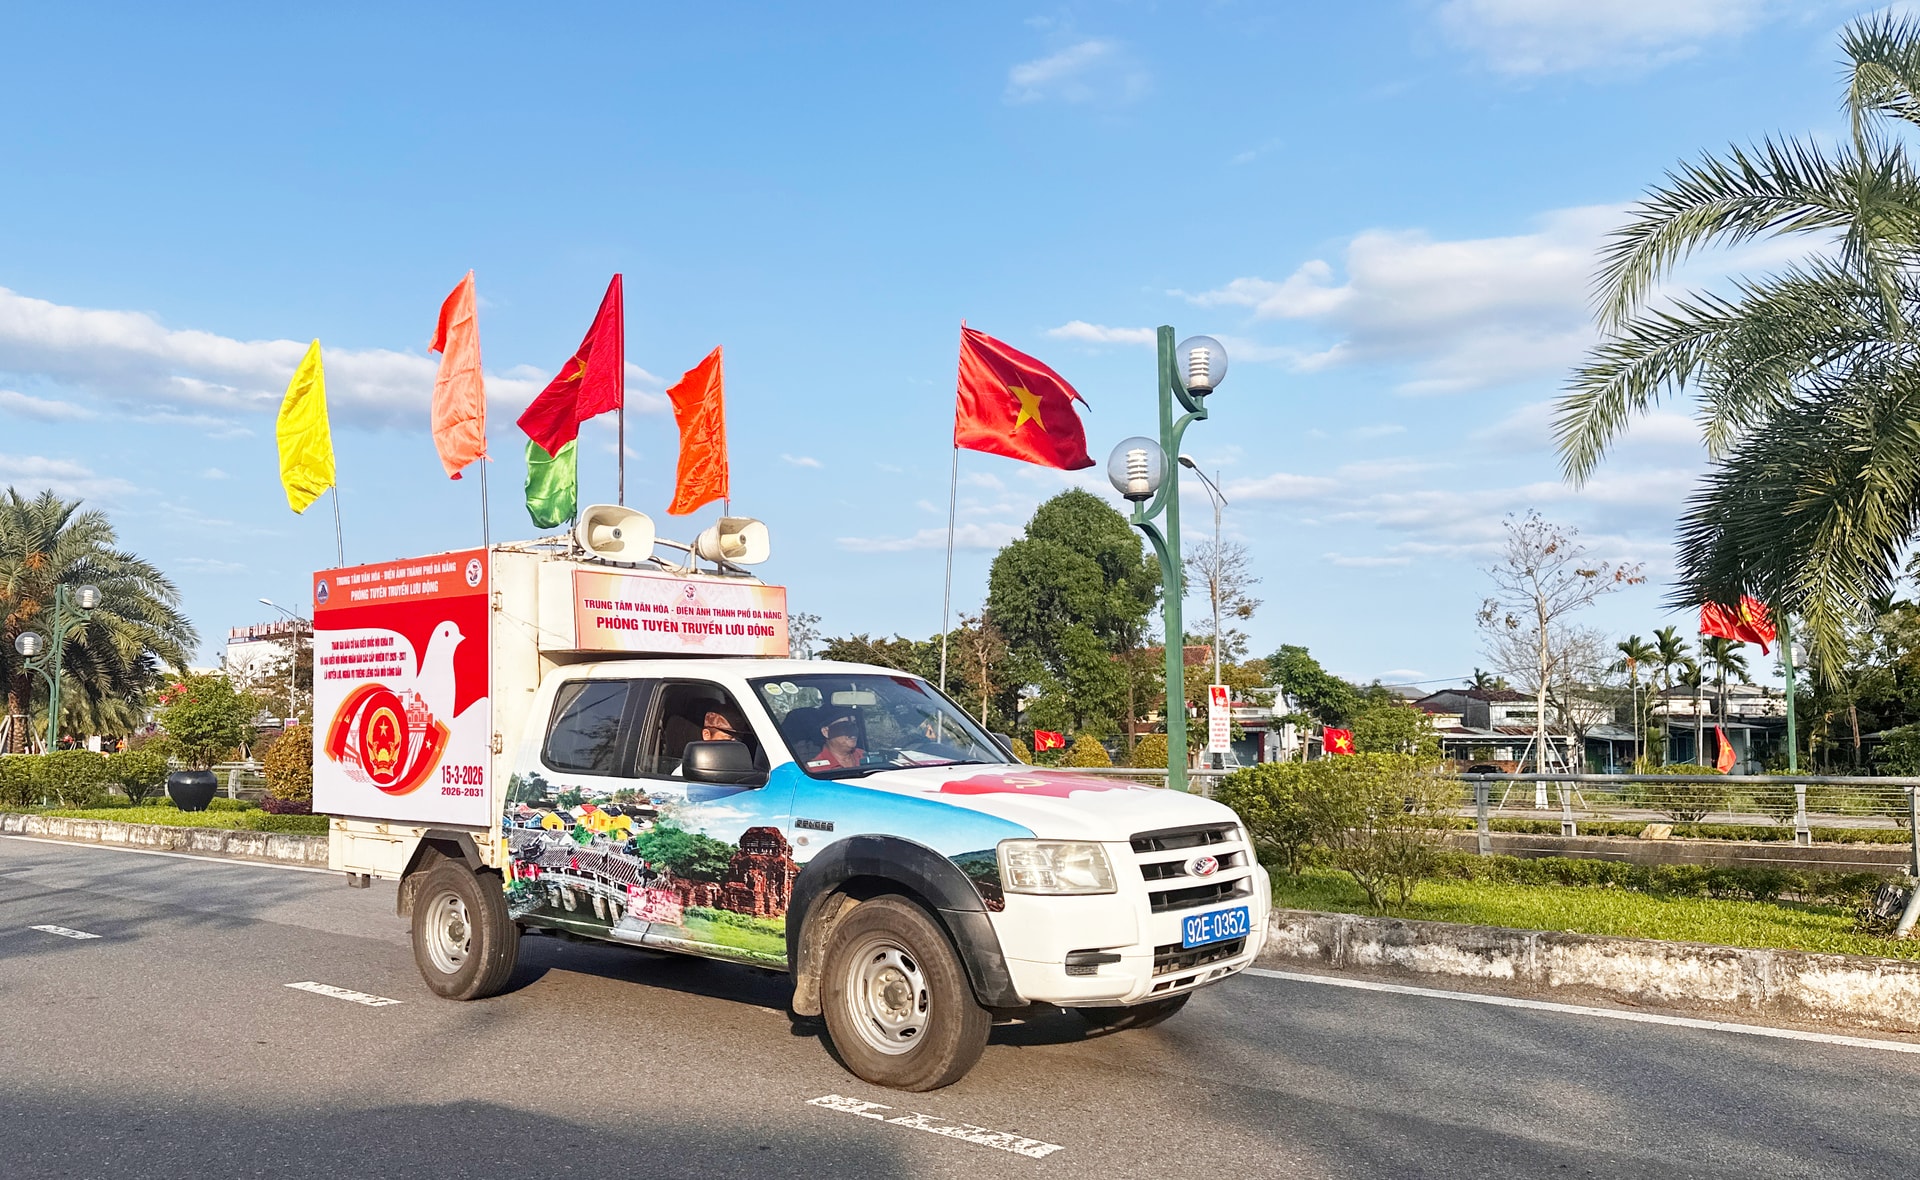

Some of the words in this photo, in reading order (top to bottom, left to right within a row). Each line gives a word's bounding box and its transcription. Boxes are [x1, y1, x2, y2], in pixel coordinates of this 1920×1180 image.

[336, 576, 350, 586] TRUNG
[351, 574, 360, 584] TÂM
[351, 588, 369, 601] PHÒNG
[410, 582, 421, 594] LƯU
[422, 580, 438, 595] ĐỘNG
[584, 600, 613, 610] TRUNG
[616, 602, 632, 611] TÂM
[712, 607, 735, 618] THÀNH
[737, 607, 751, 619] PHỐ
[752, 609, 762, 619] ĐÀ
[596, 615, 638, 630] PHÒNG
[642, 619, 679, 633] TUYÊN
[726, 625, 745, 635] LƯU
[747, 625, 775, 639] ĐỘNG
[442, 765, 483, 785] 15-3-2026
[441, 787, 483, 797] 2026-2031
